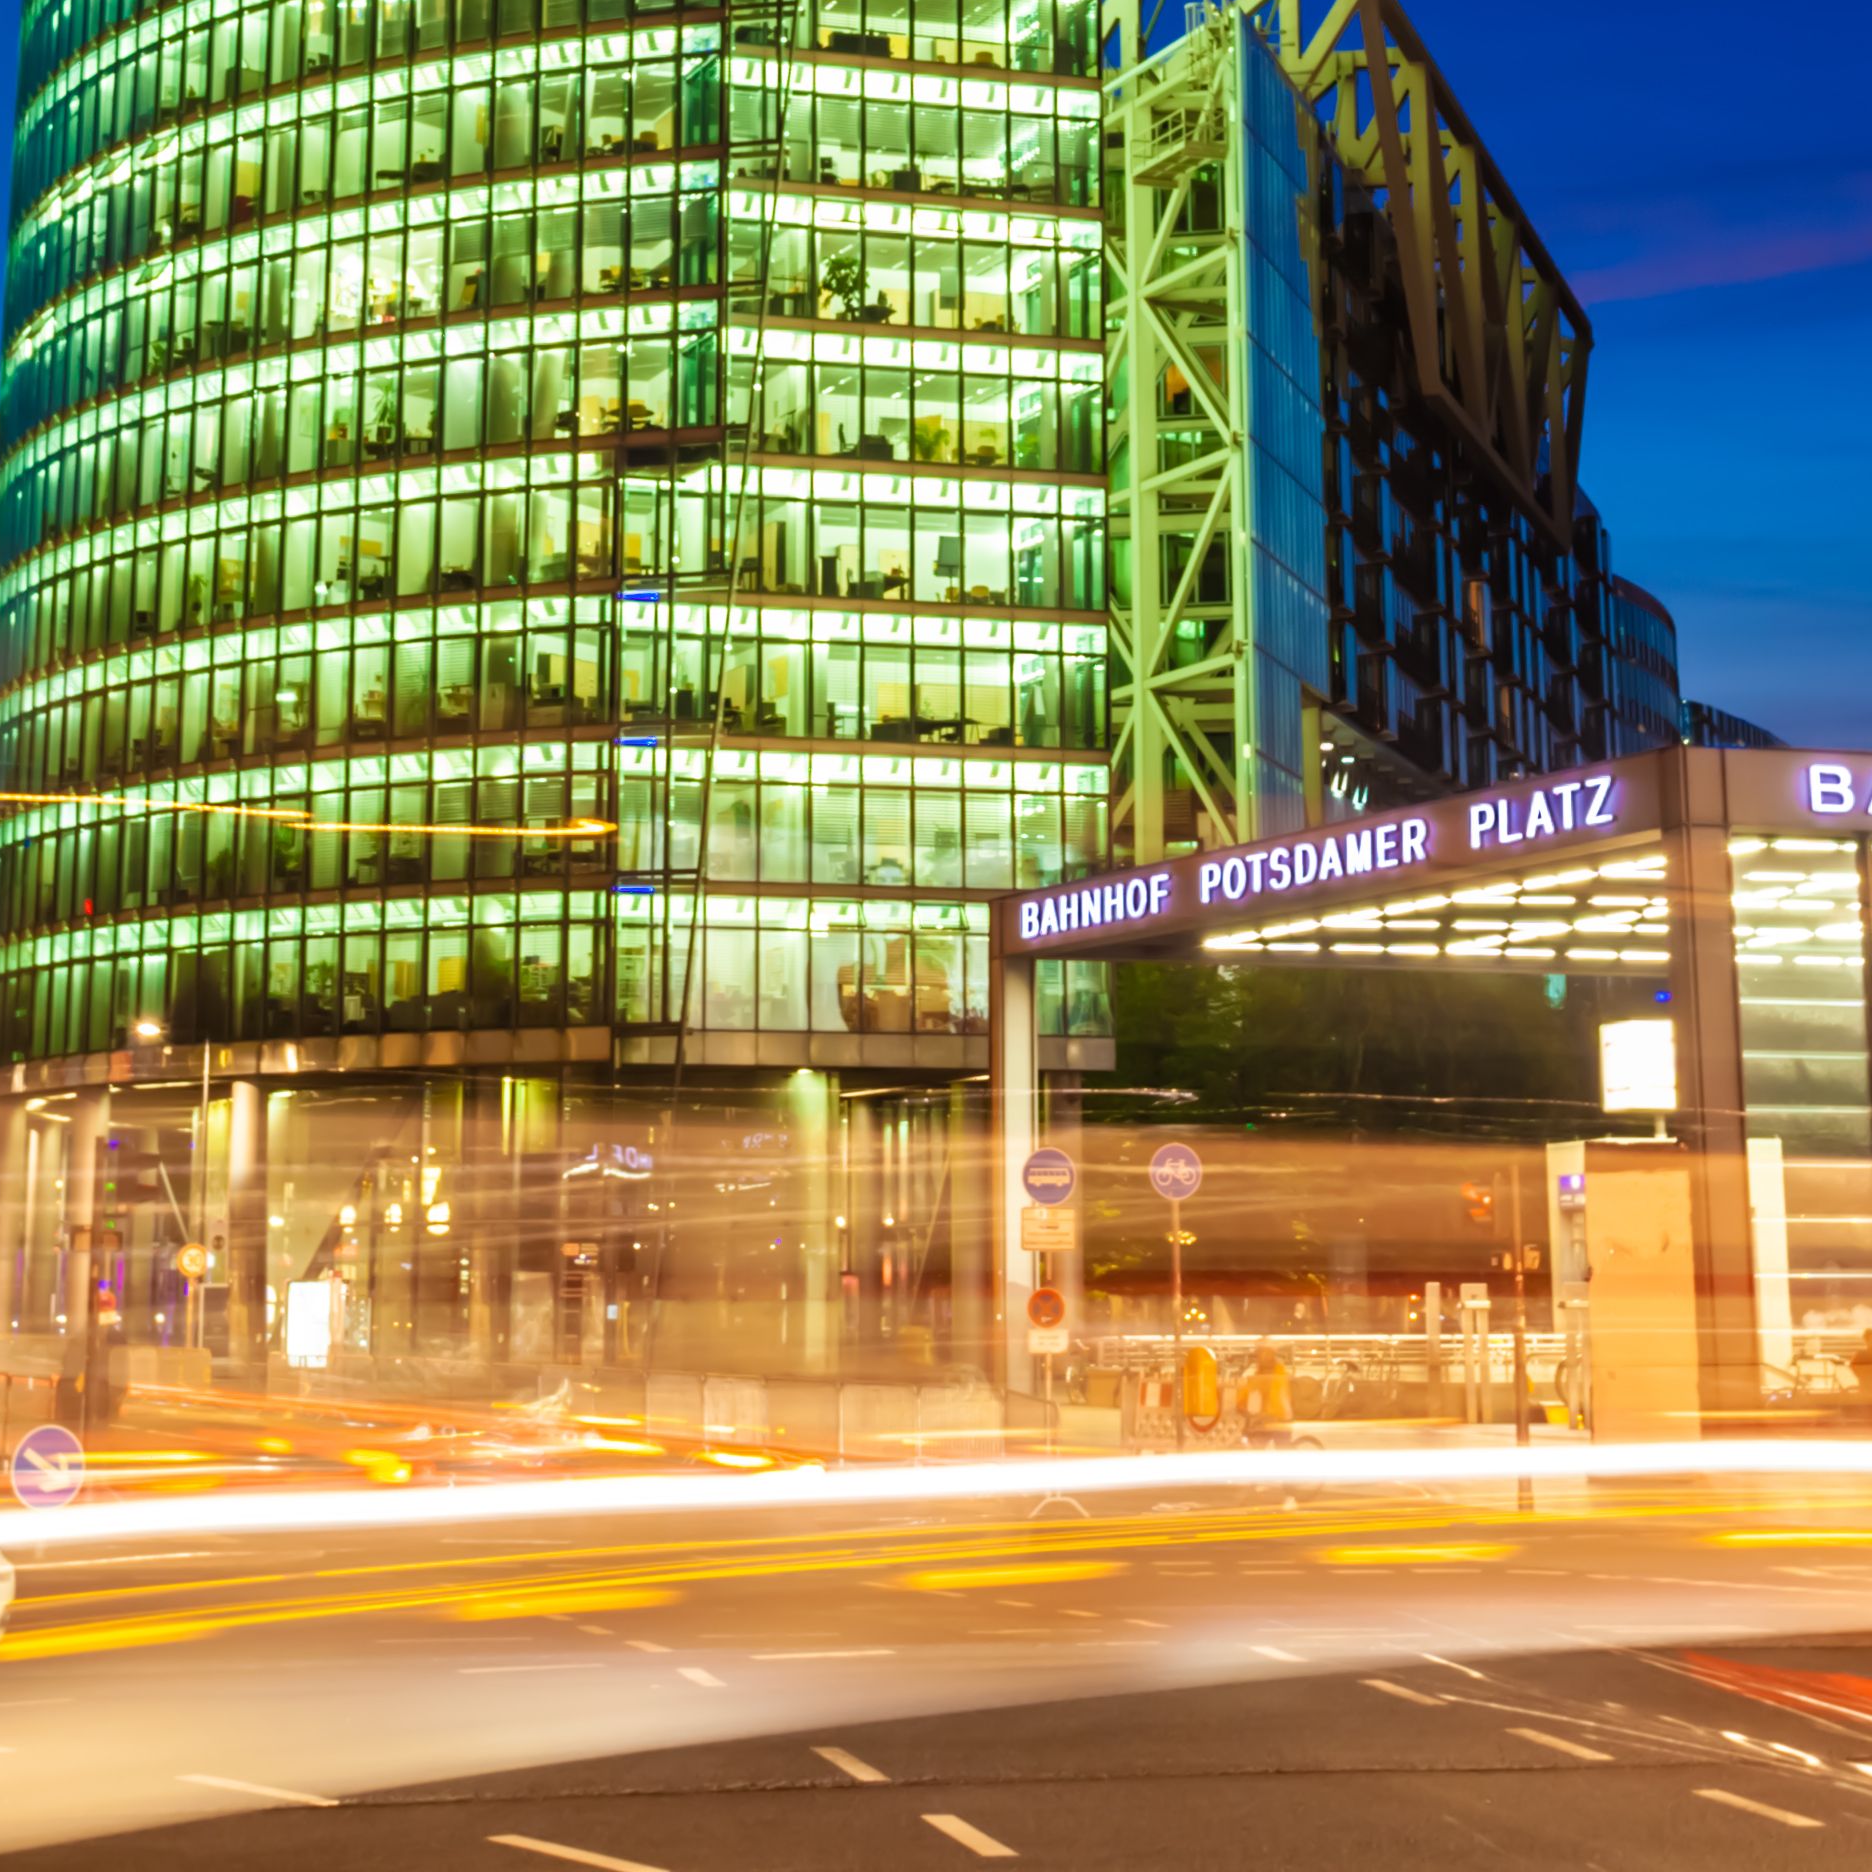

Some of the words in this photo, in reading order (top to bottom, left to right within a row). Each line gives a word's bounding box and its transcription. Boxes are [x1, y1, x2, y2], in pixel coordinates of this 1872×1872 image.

[1020, 872, 1170, 940] BAHNHOF
[1200, 818, 1428, 905] POTSDAMER
[1469, 774, 1615, 849] PLATZ
